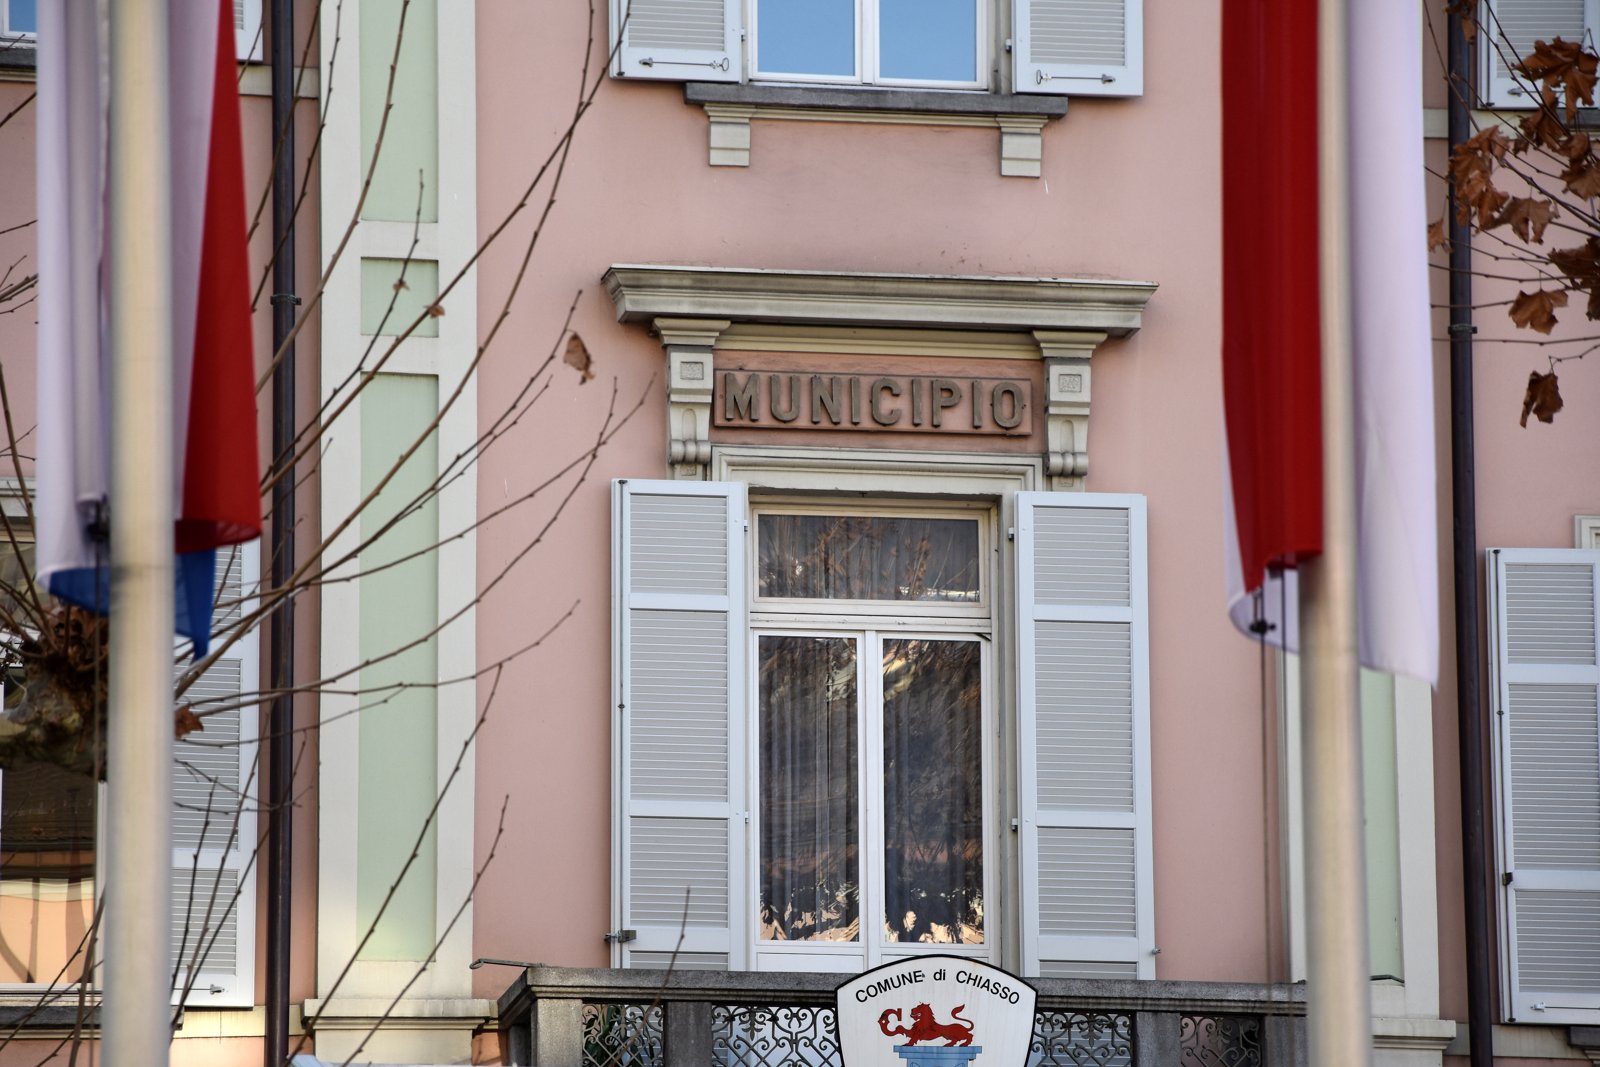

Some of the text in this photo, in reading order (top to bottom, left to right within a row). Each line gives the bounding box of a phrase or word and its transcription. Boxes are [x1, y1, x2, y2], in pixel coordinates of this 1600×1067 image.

[724, 372, 1024, 429] MUNICIPIO
[855, 968, 1020, 1005] COMUNE di CHIASSO
